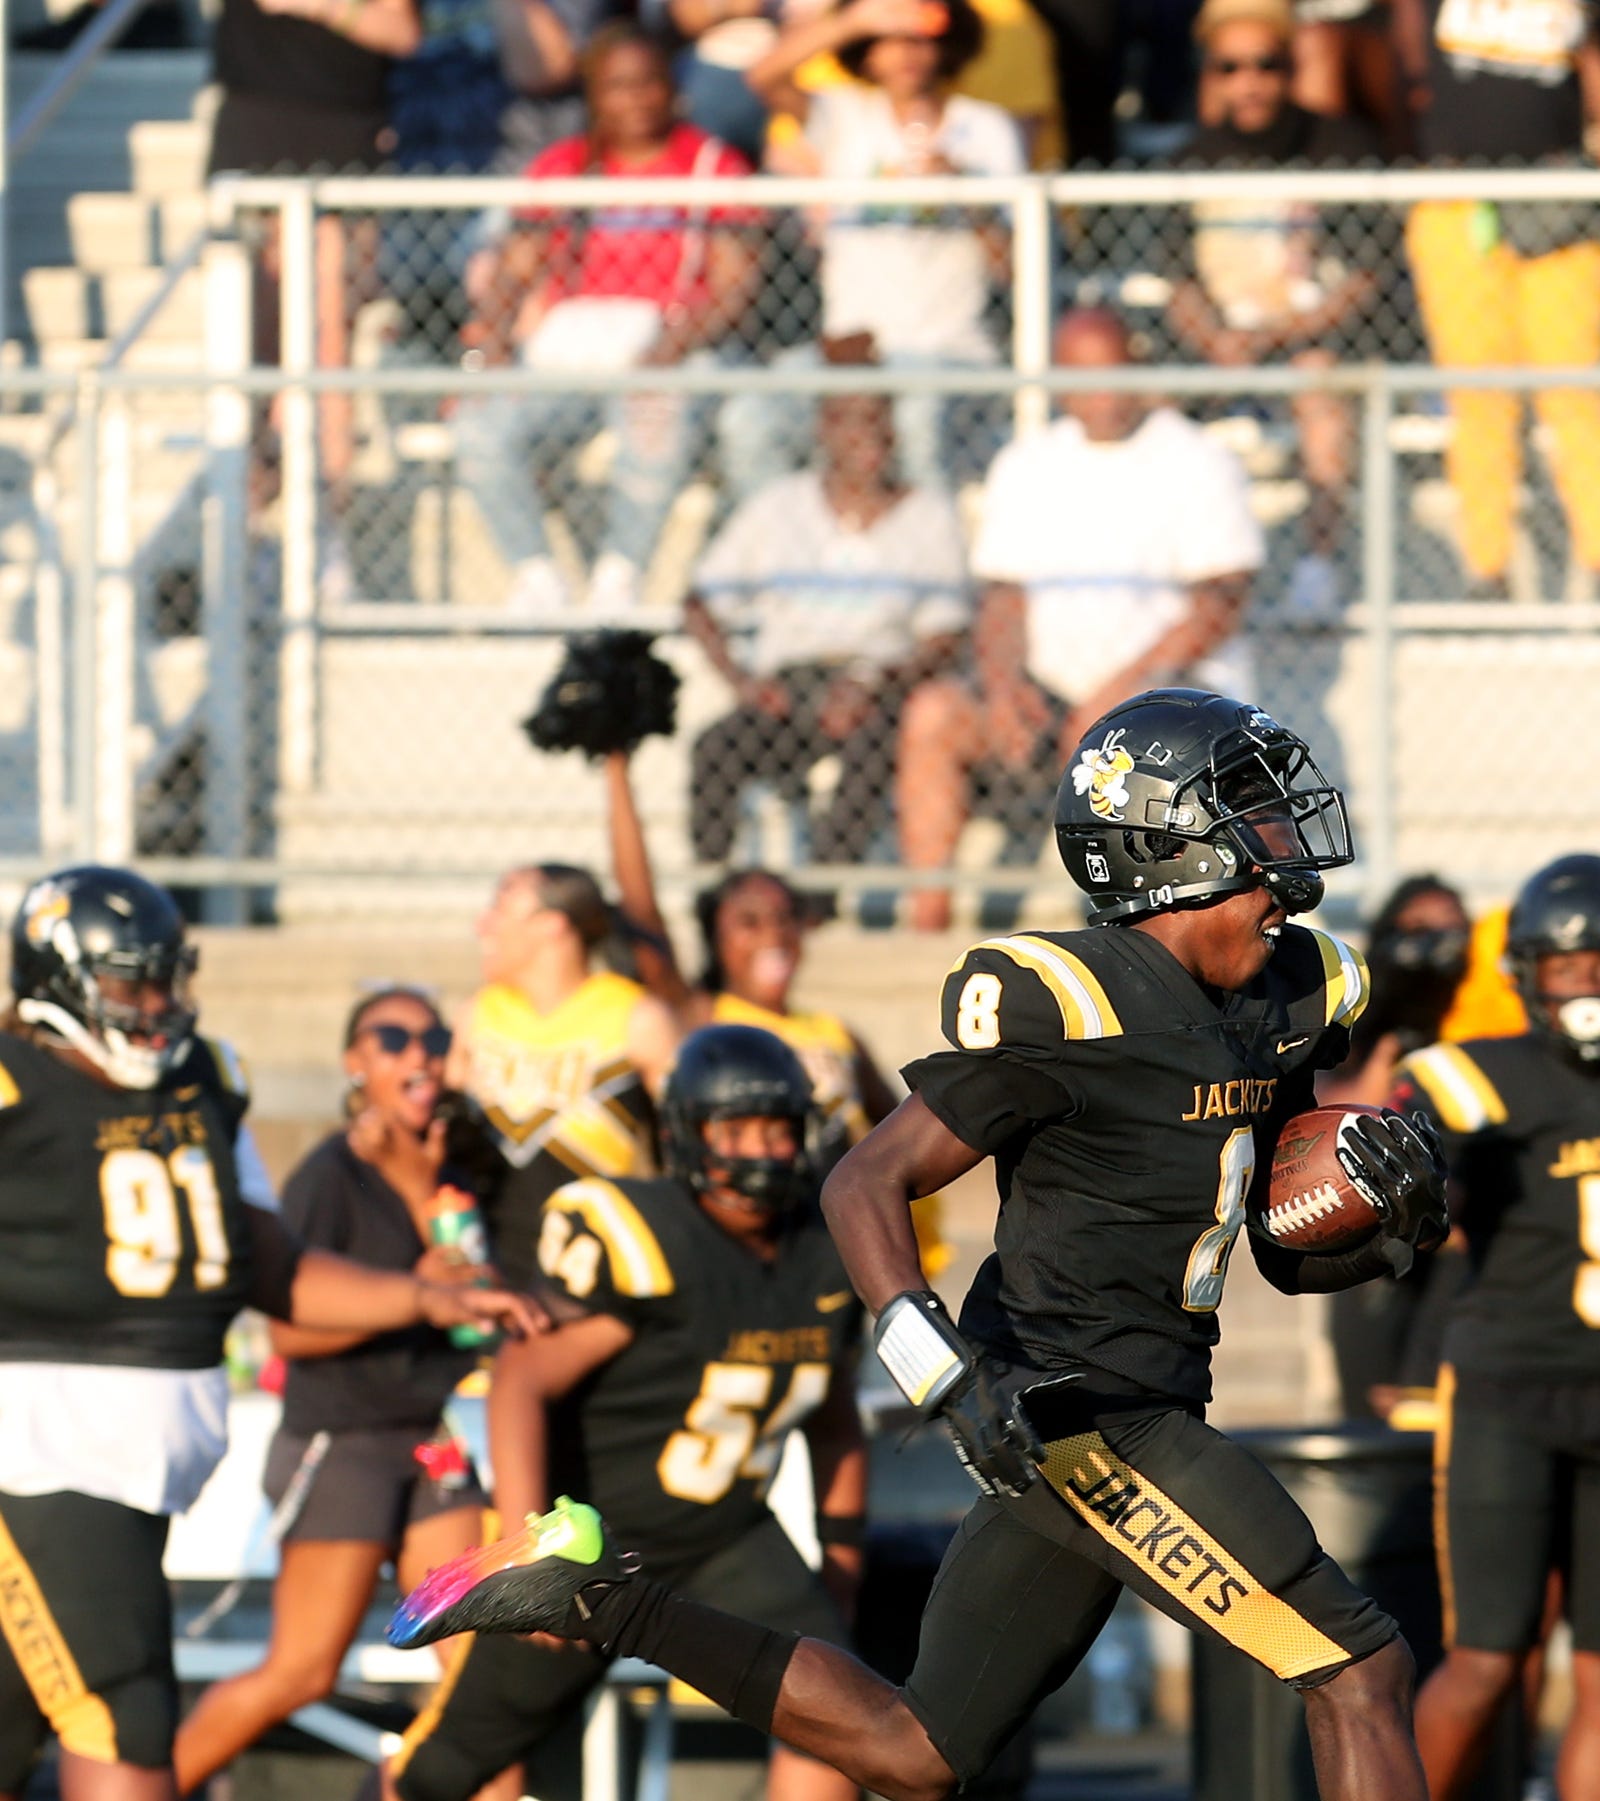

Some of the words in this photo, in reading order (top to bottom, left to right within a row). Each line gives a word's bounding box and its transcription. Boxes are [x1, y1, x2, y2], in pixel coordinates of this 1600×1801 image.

[957, 971, 1004, 1050] 8
[94, 1111, 208, 1150] JACKTS
[1181, 1078, 1278, 1121] JACKETS
[99, 1144, 230, 1298] 91
[1181, 1123, 1256, 1313] 8
[1064, 1469, 1250, 1617] JACKETS
